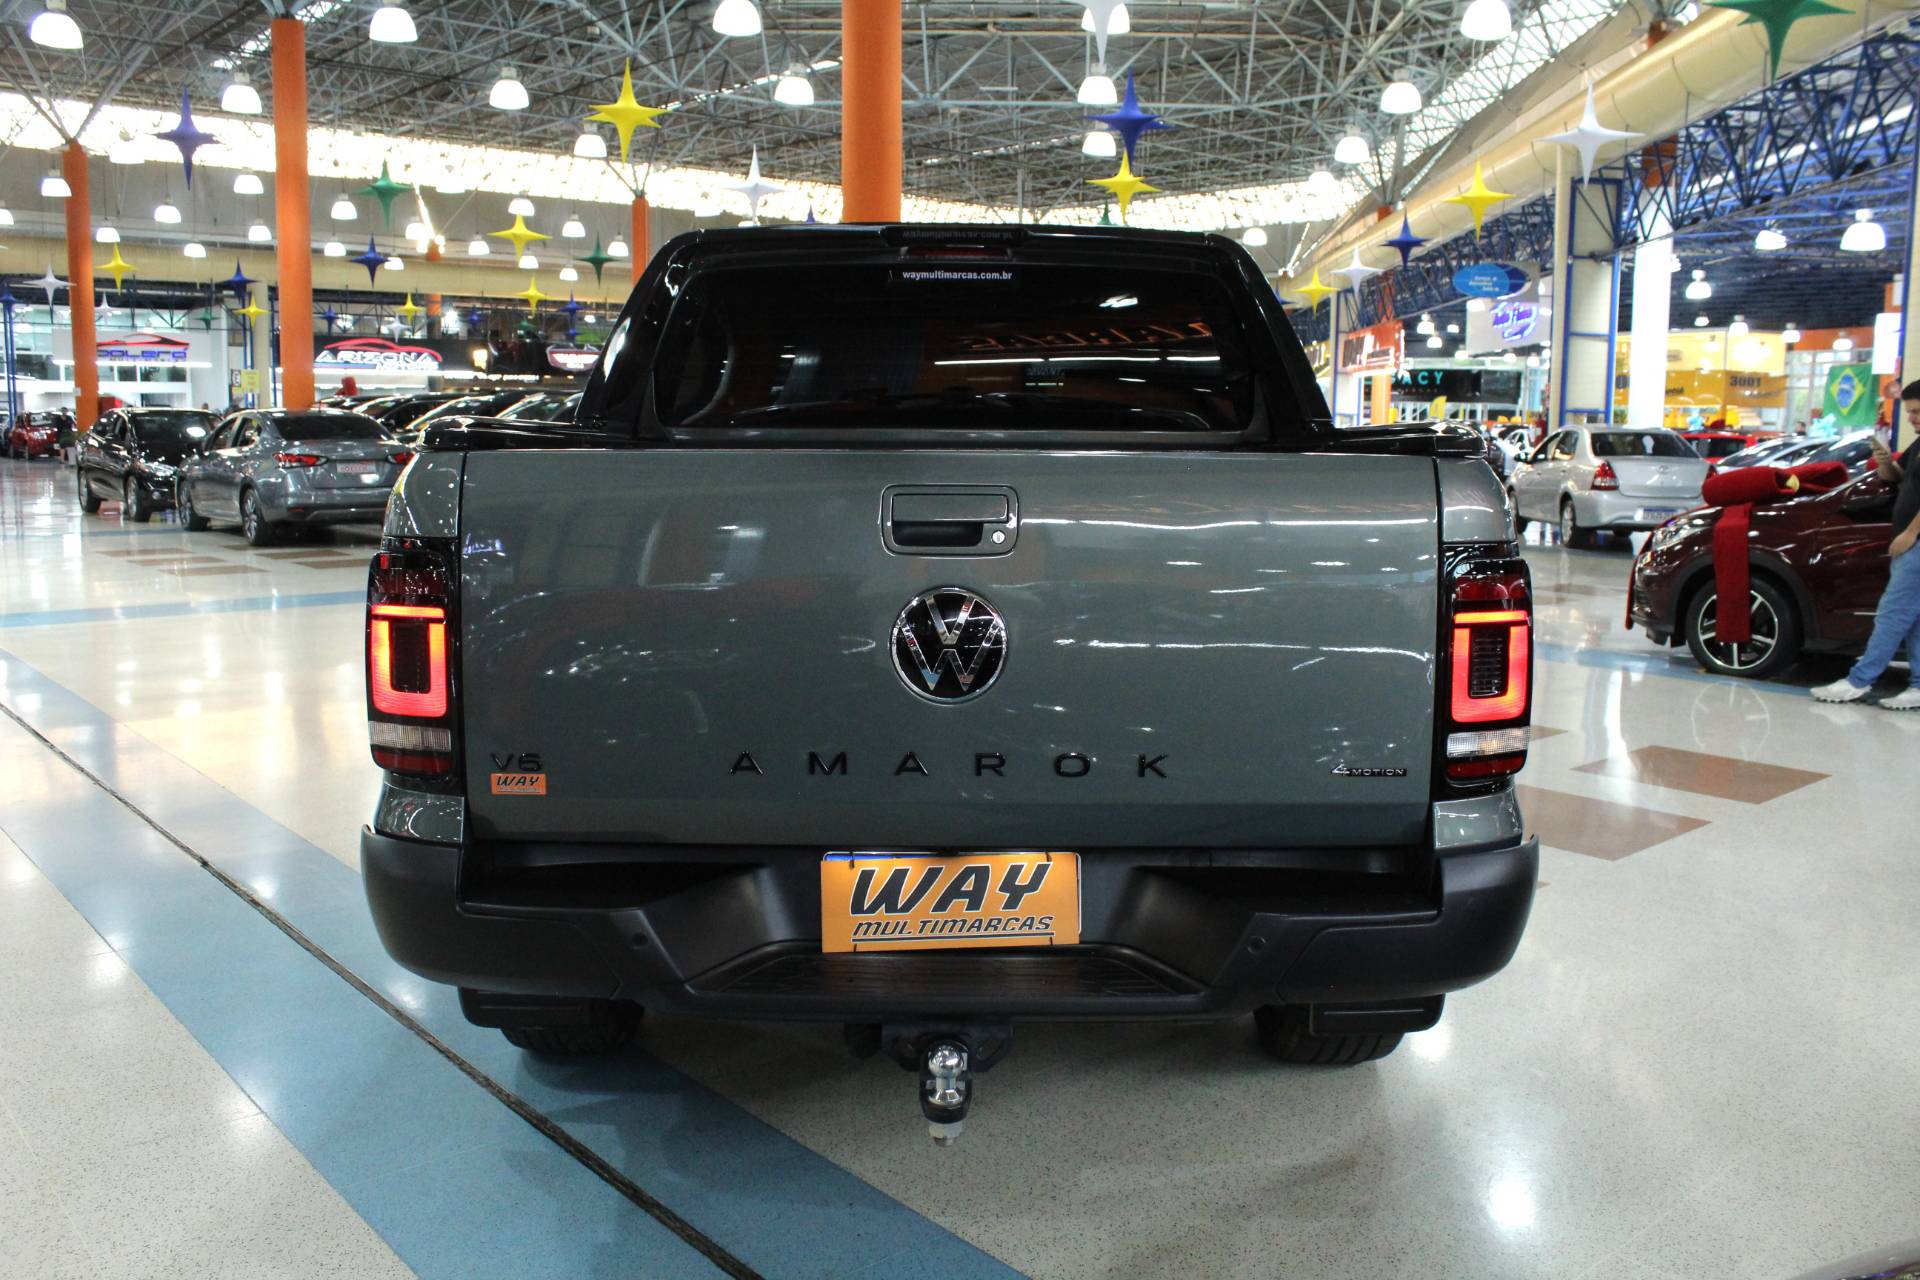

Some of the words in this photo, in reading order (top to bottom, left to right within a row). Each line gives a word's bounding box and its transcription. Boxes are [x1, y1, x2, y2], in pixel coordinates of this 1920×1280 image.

[902, 270, 1013, 281] waymultimarcas.com.br
[315, 350, 436, 364] ARIZONA
[490, 752, 544, 771] V6
[729, 749, 1169, 778] AMAROK
[1331, 760, 1405, 776] 4MOTION
[496, 775, 540, 787] WAY
[850, 861, 1054, 917] WAY
[852, 915, 1056, 937] MULTIMARCAS
